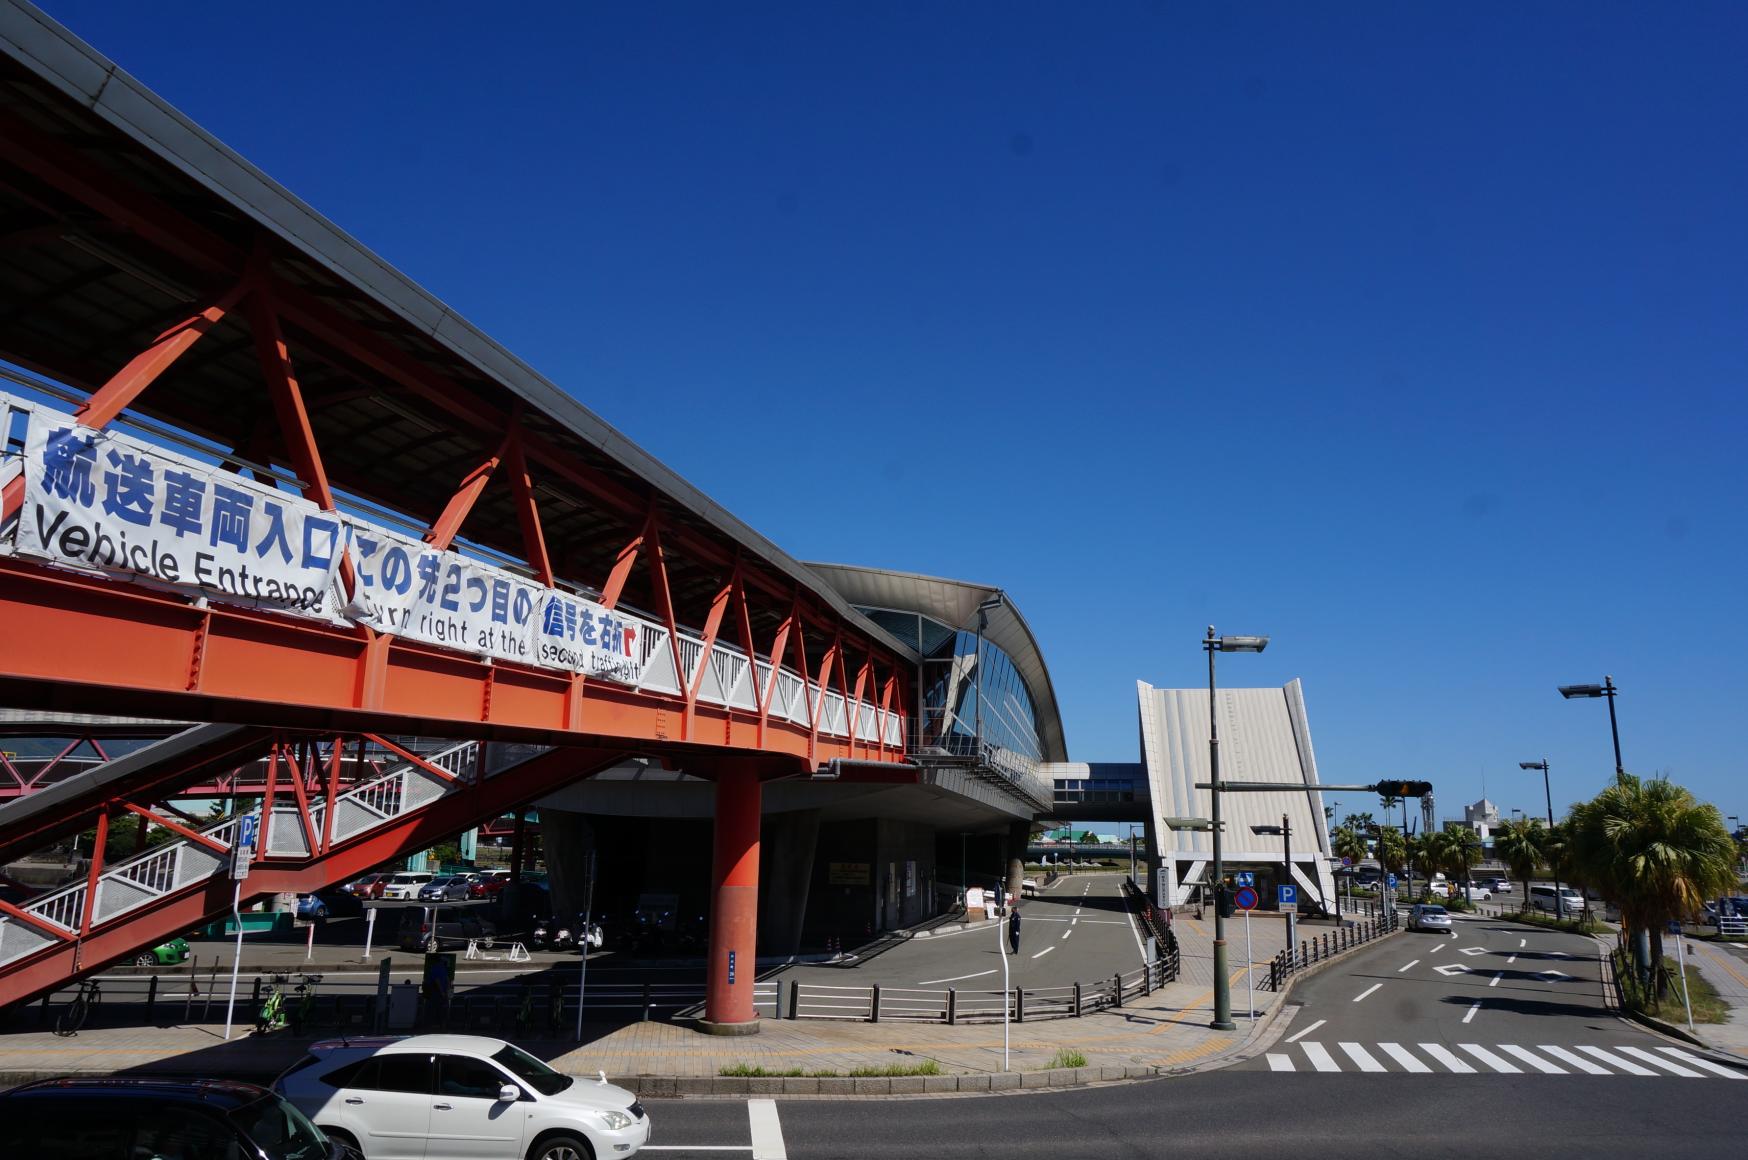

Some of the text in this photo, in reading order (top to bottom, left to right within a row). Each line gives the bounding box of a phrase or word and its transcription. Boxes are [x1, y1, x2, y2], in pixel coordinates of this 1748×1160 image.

[41, 427, 339, 573] 航送車両入口
[36, 504, 324, 613] Vehicle Entrance
[420, 611, 467, 643] right
[478, 627, 494, 650] at
[501, 630, 526, 656] the
[242, 818, 252, 843] P
[1282, 886, 1293, 902] P
